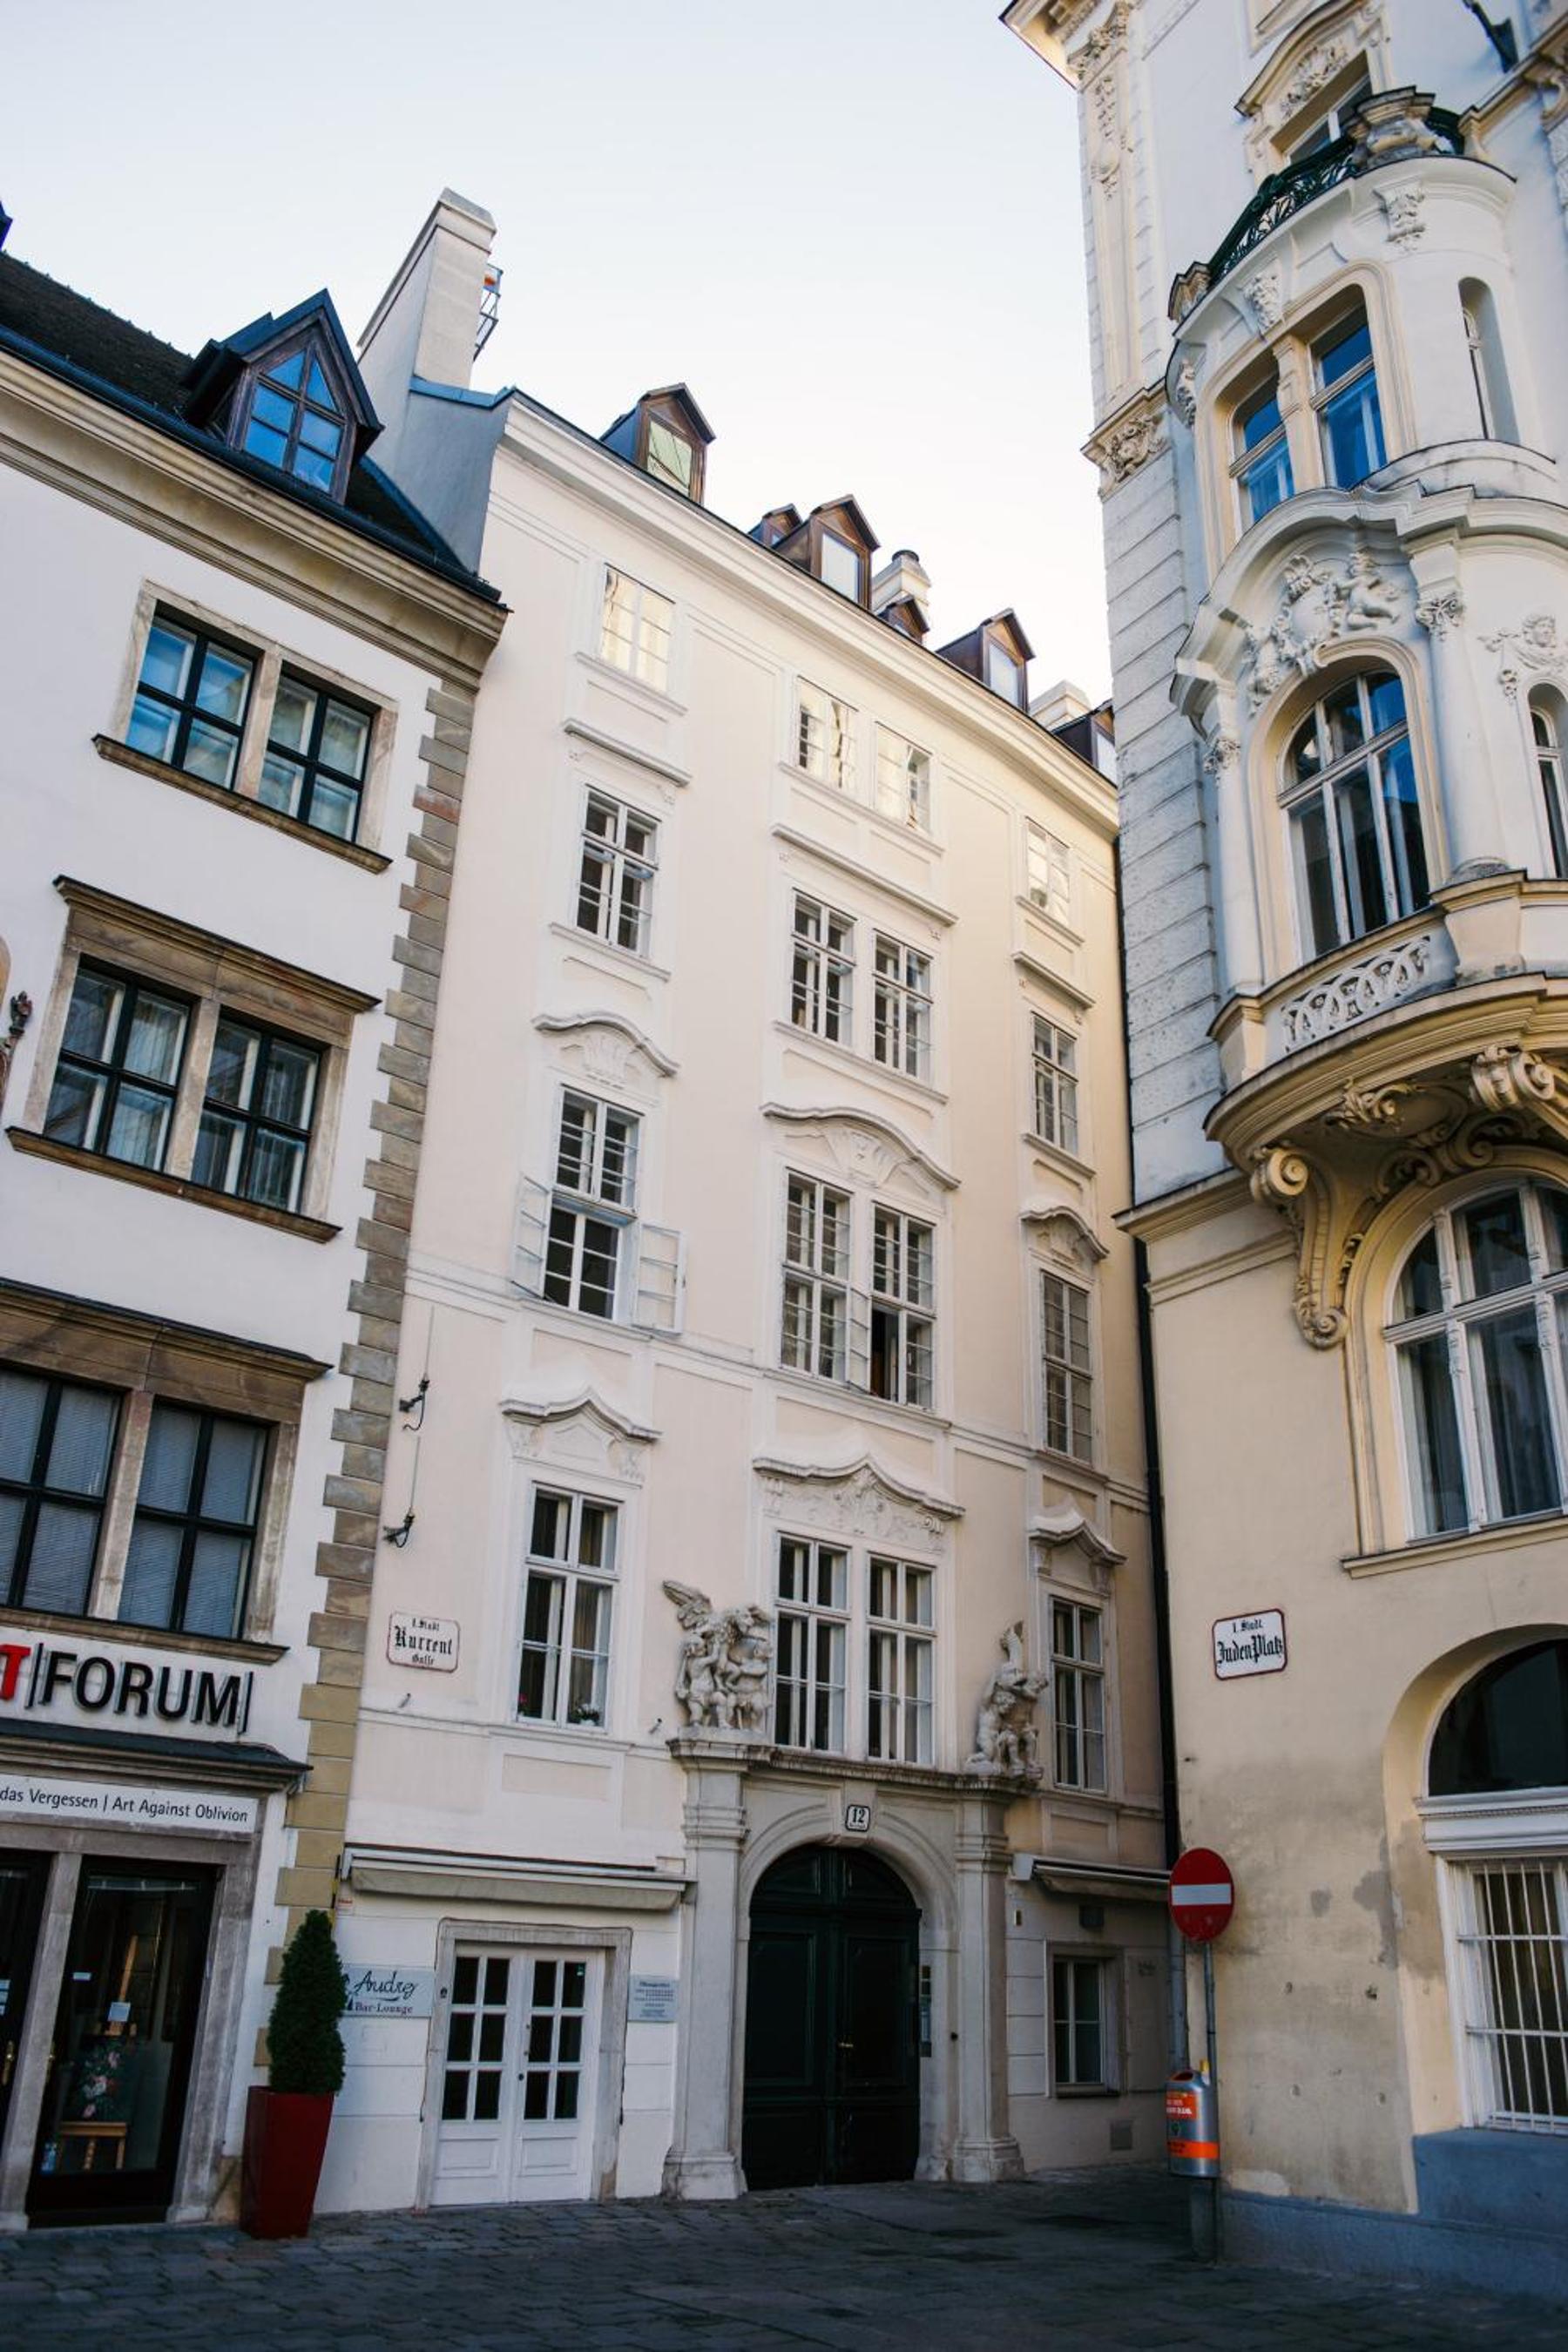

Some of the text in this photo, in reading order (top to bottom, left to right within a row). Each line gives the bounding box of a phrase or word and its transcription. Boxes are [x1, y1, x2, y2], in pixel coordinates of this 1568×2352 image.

[0, 1786, 24, 1802] das
[29, 1788, 98, 1809] Vergessen
[112, 1796, 134, 1813] Art
[139, 1799, 190, 1818] Against
[195, 1803, 248, 1822] Oblivion
[853, 1808, 866, 1823] 12
